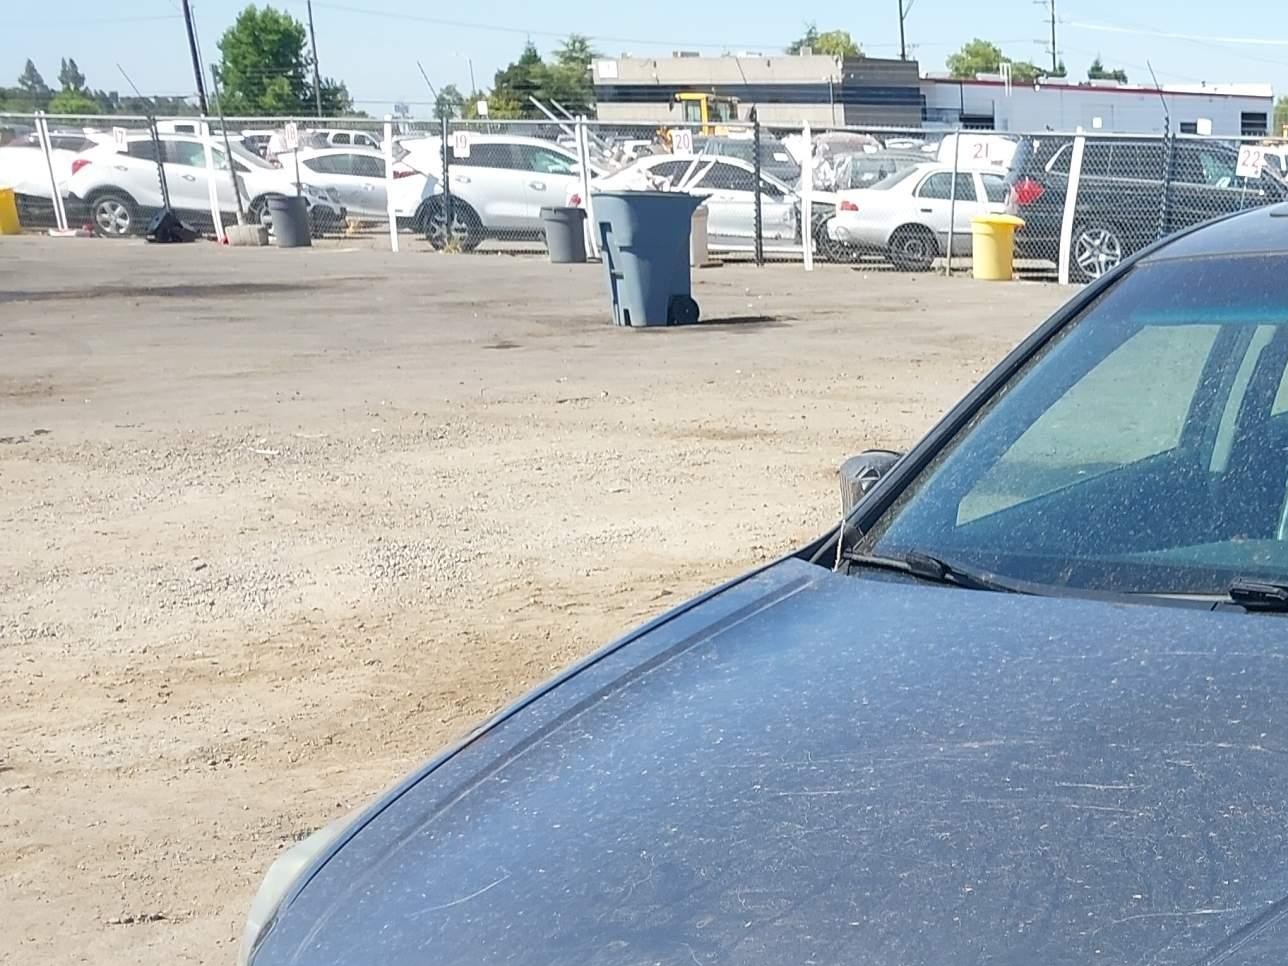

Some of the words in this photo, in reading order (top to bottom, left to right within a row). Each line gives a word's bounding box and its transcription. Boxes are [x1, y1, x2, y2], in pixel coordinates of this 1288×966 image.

[455, 134, 467, 149] 19
[675, 133, 690, 149] 20
[973, 143, 989, 159] 21
[1241, 149, 1261, 168] 22
